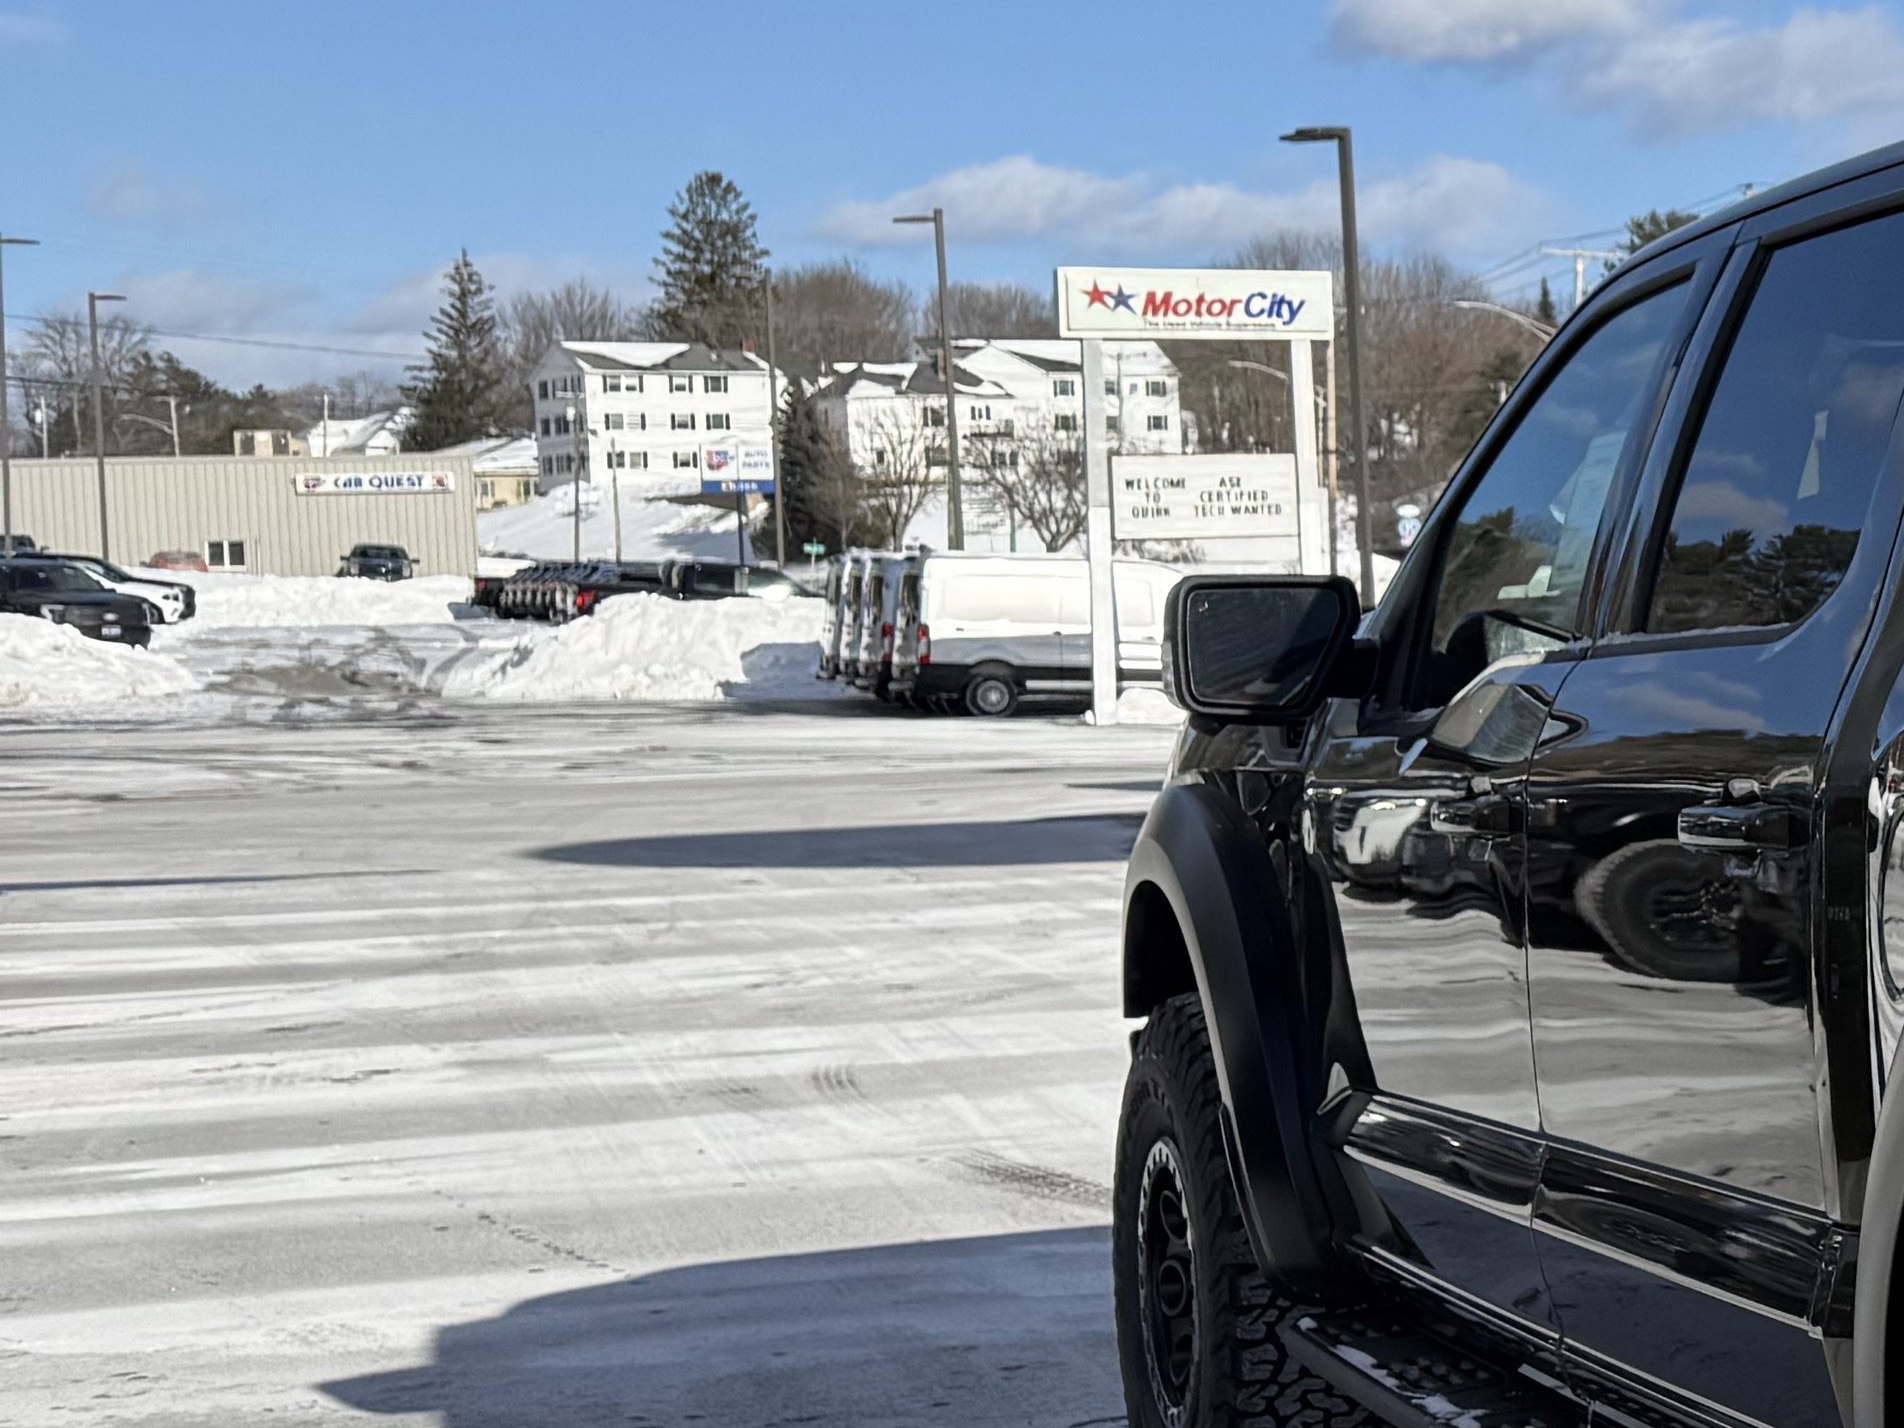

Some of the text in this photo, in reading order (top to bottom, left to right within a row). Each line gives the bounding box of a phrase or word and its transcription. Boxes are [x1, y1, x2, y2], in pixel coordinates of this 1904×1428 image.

[1142, 290, 1306, 325] MotorCity
[1125, 476, 1187, 491] WELCOME
[1145, 491, 1161, 504] TO
[1199, 489, 1270, 503] CERTIFIED
[1231, 502, 1282, 516] WANTED
